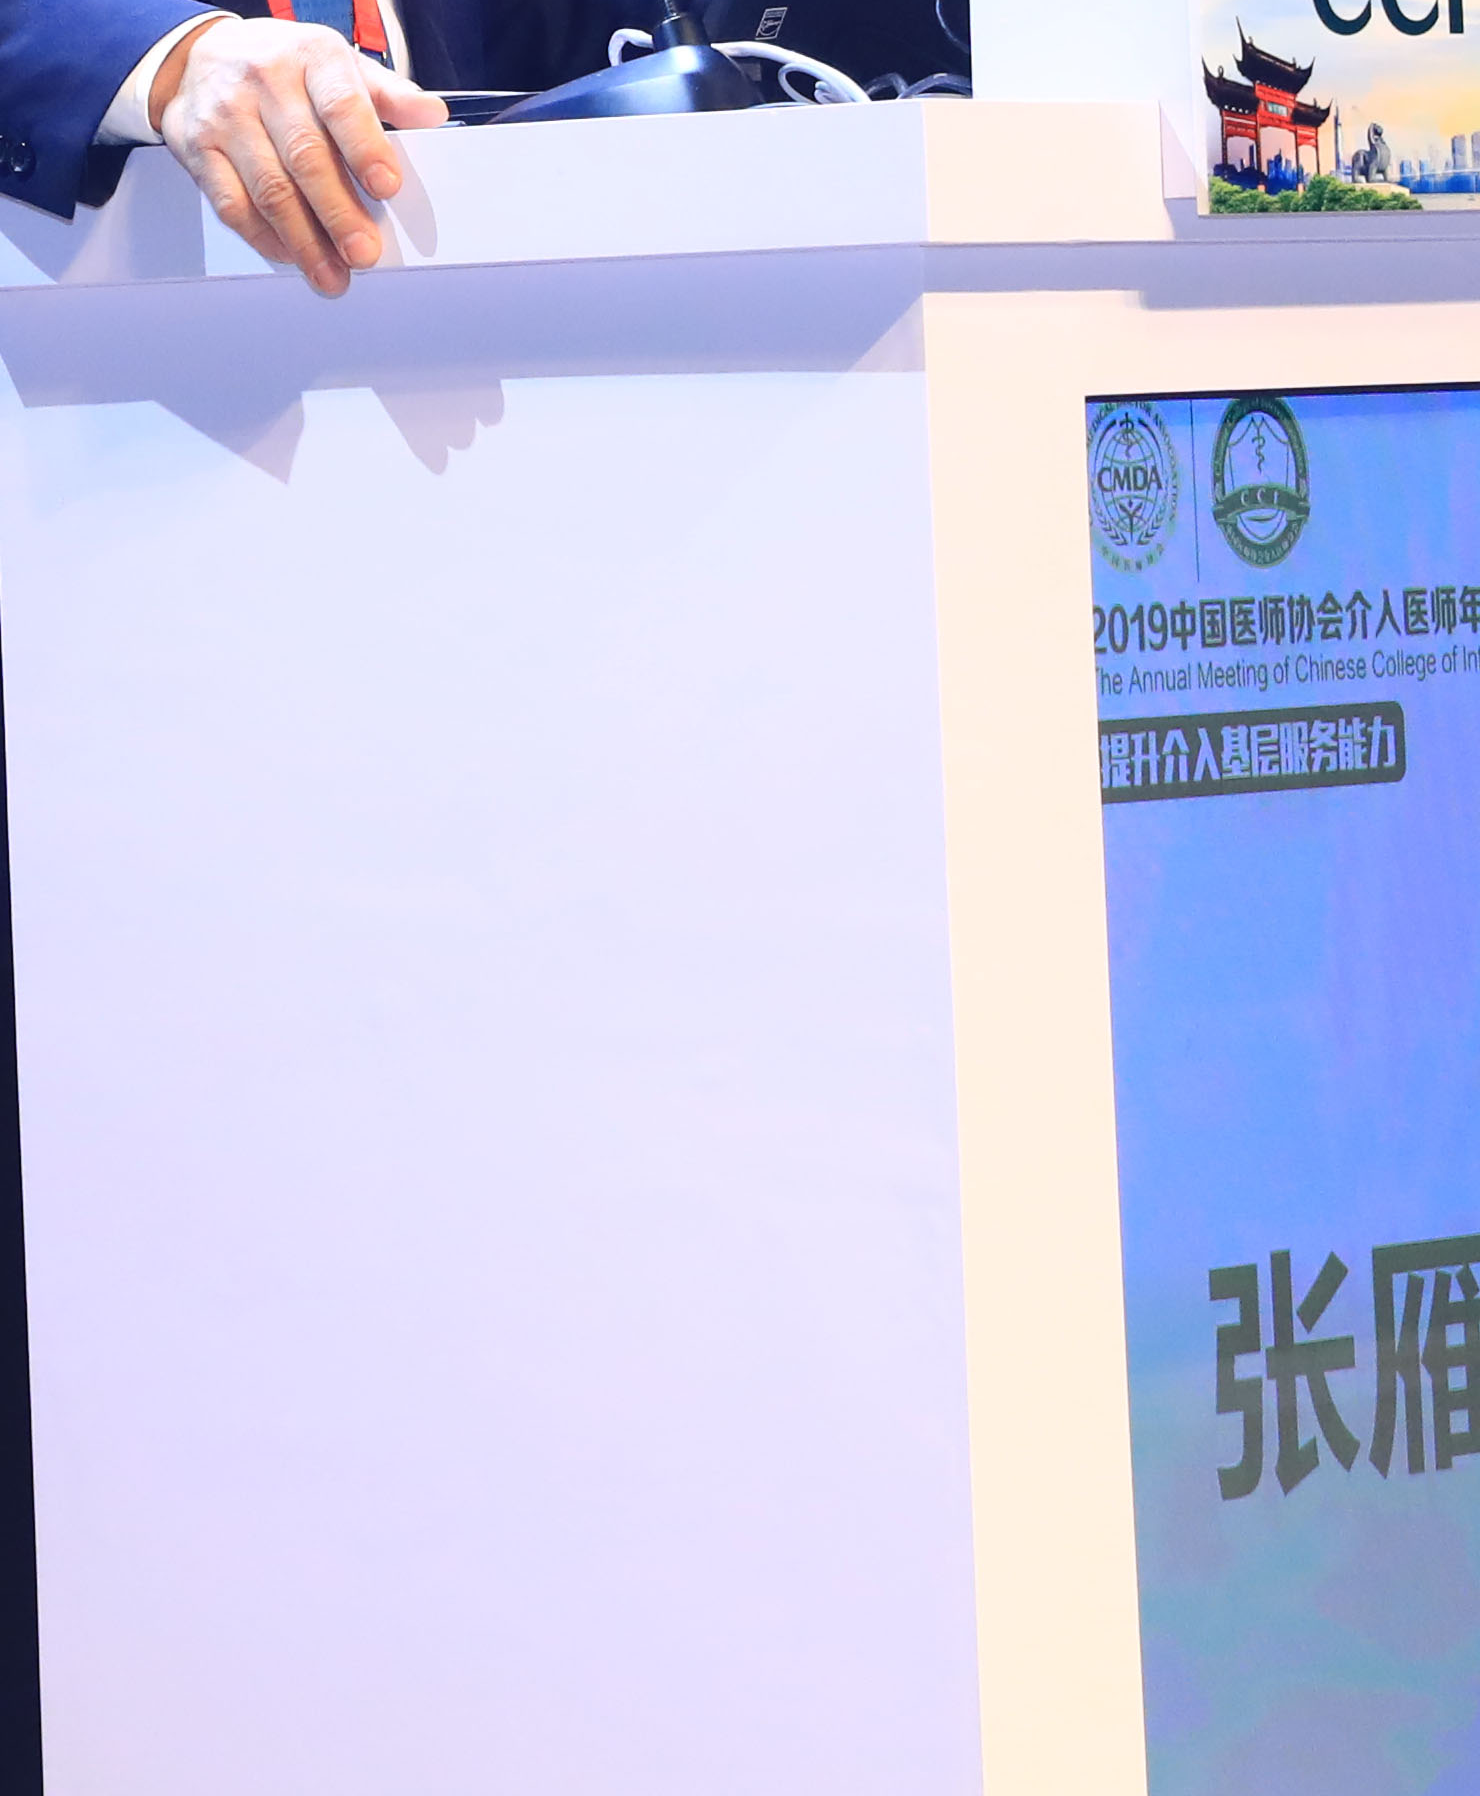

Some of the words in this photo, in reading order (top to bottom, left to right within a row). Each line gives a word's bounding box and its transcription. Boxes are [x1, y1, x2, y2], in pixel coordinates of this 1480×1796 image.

[1097, 463, 1162, 492] CMDA
[1240, 487, 1280, 505] CCI
[1129, 662, 1191, 694] Annual
[1198, 659, 1268, 692] Meeting
[1274, 655, 1290, 684] of
[1295, 652, 1367, 682] Chinese
[1372, 649, 1436, 681] College
[1441, 645, 1458, 673] of
[1100, 715, 1396, 789] 提升介入基层服务能力
